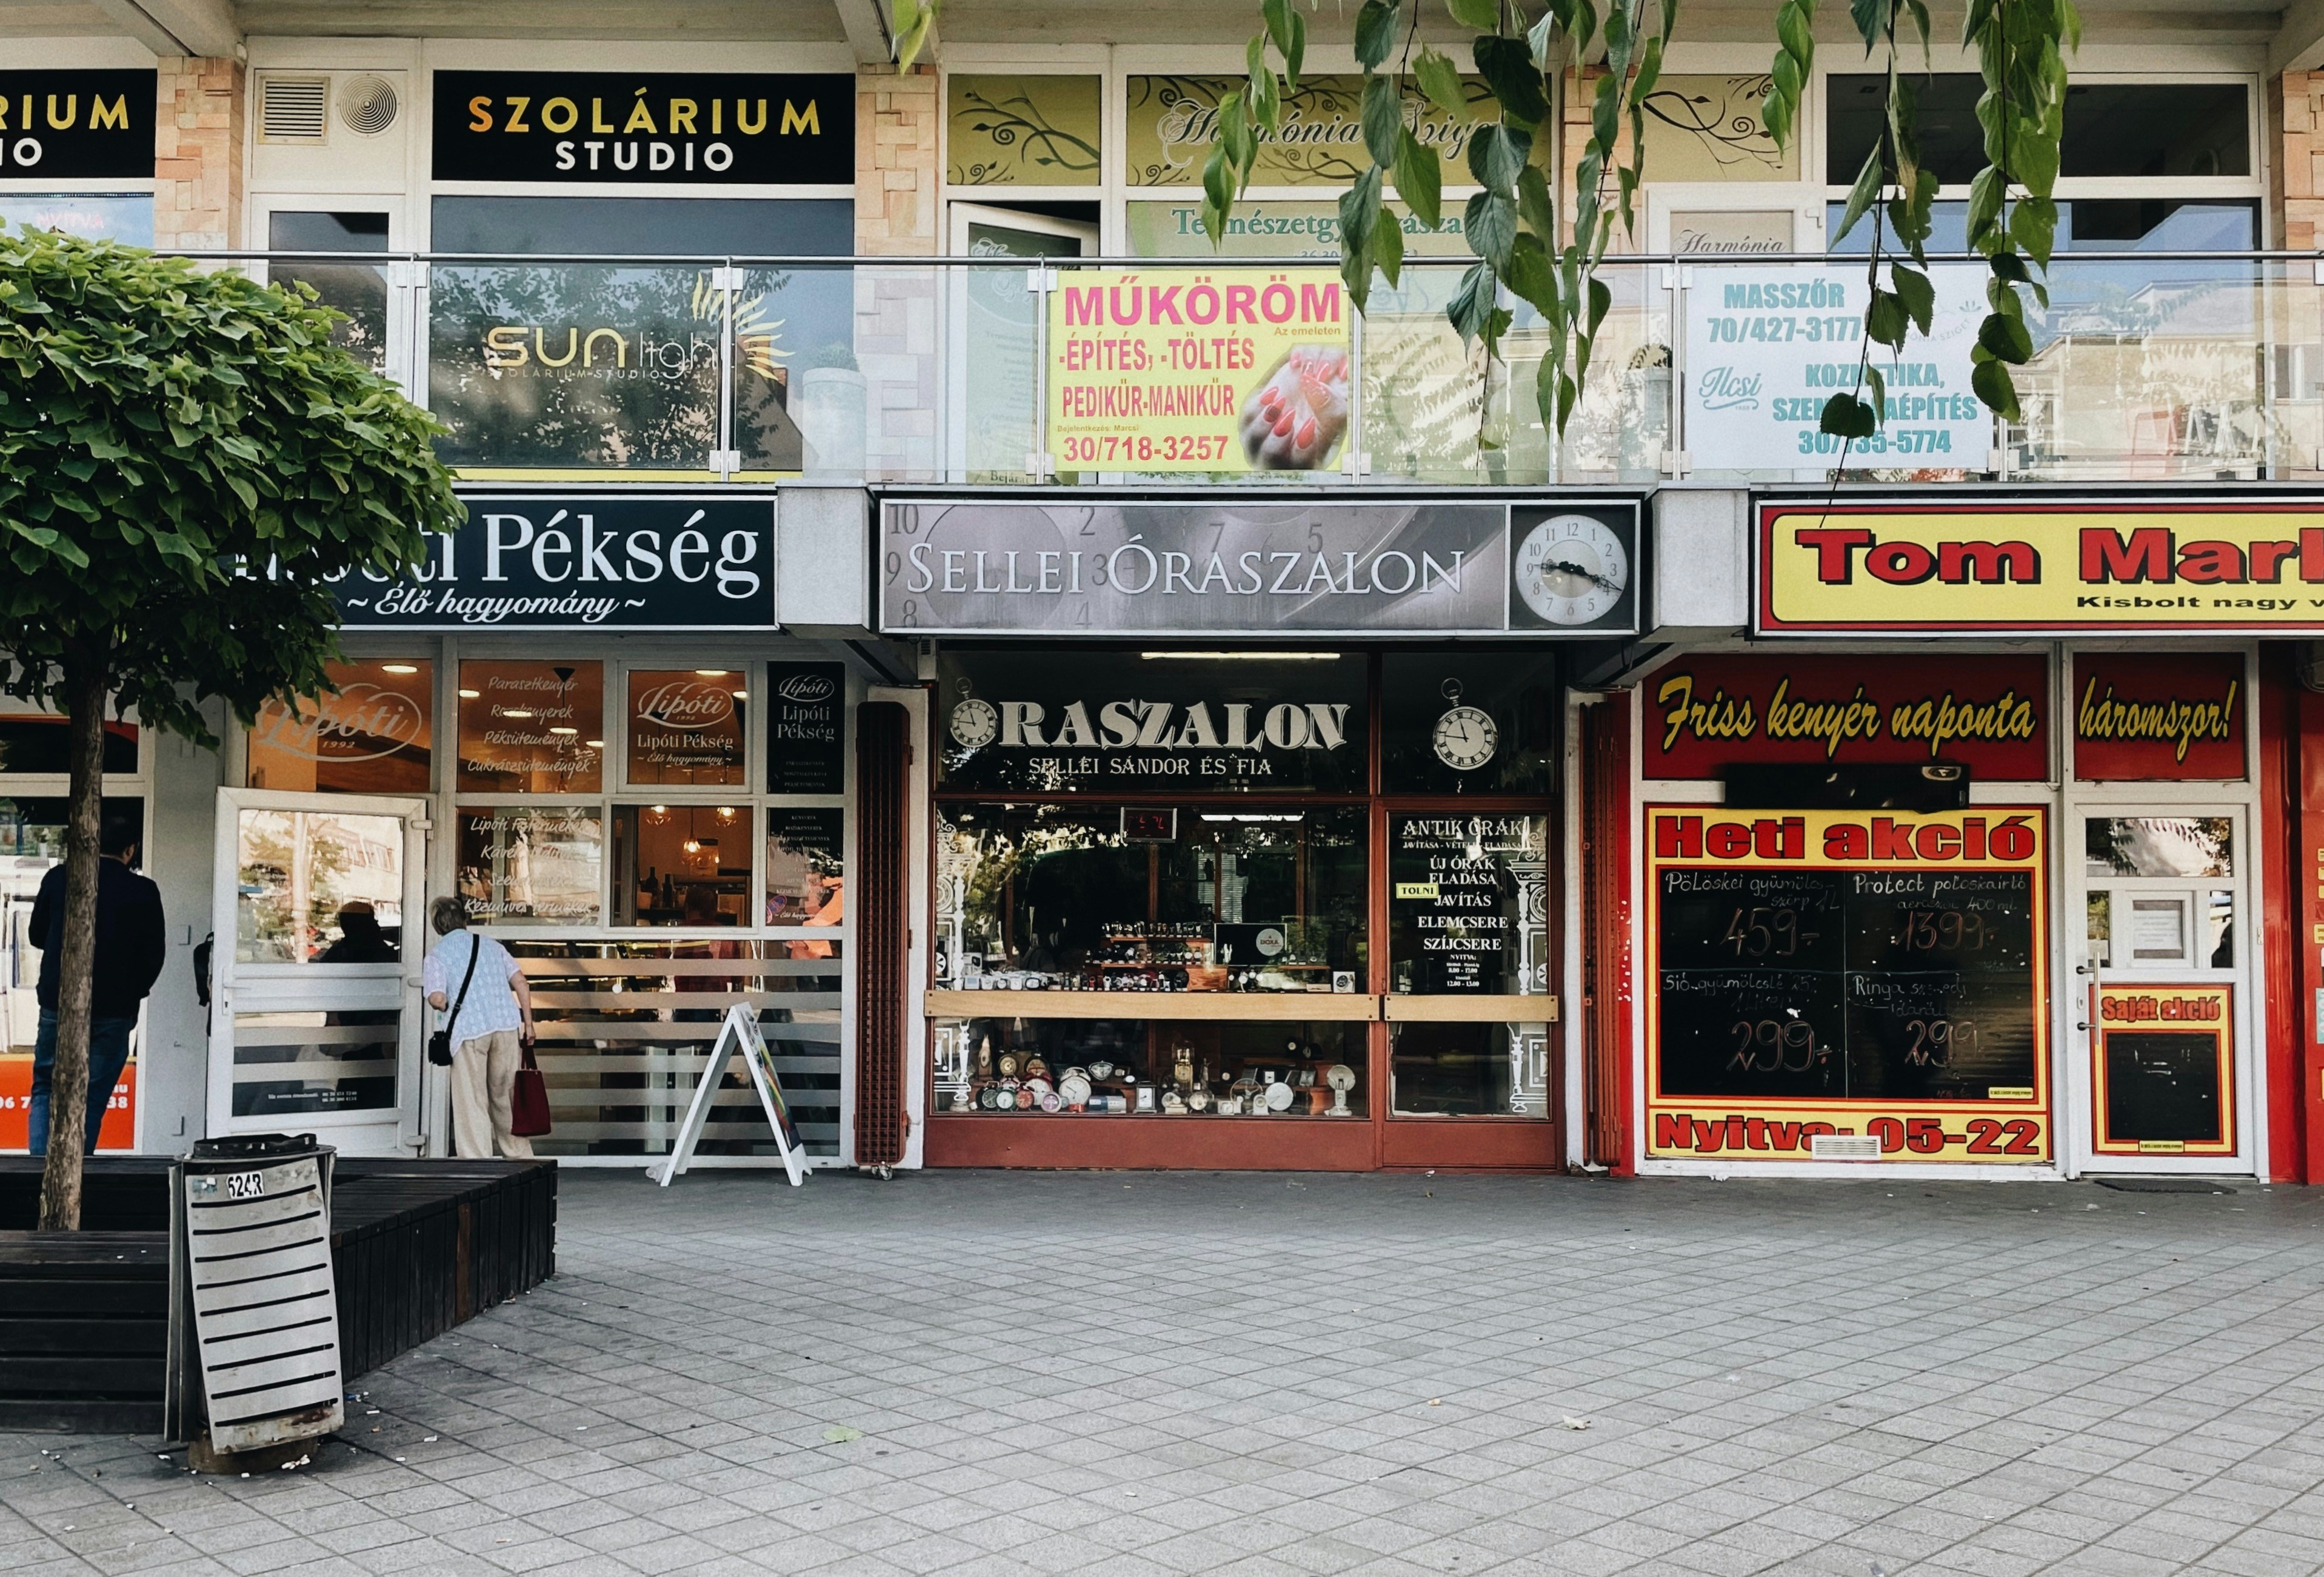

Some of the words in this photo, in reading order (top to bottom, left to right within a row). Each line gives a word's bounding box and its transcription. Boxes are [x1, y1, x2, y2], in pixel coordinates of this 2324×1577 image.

[469, 87, 821, 135] SZOLÁRIUM
[555, 141, 734, 172] STUDIO
[1671, 230, 1787, 254] Harmónia
[1064, 275, 1341, 326] MŰKÖRÖM
[1724, 278, 1845, 308] MASSZŐR
[1274, 327, 1289, 336] Az
[1292, 327, 1341, 336] emeleten
[1707, 316, 1862, 343] 70/427-3177
[1059, 331, 1154, 371] -ÉPÍTÉS,
[1161, 330, 1255, 370] -TÖLTÉS
[1698, 366, 1763, 398] Ilcsi
[1063, 378, 1235, 417] PEDIKÜR-MANIKÜR
[1063, 435, 1229, 462] 30/718-3257
[1546, 527, 1556, 541] 11
[1566, 522, 1579, 536] 12
[1591, 527, 1596, 541] 1
[481, 508, 760, 599] Pékség
[1529, 543, 1541, 557] 10
[1605, 543, 1612, 557] 2
[1795, 528, 2042, 585] Tom
[907, 542, 1084, 594] SELLEI
[1107, 533, 1464, 595] ÓRASZALON
[1527, 562, 1534, 577] 9
[1609, 563, 1617, 576] 3
[1533, 582, 1540, 595] 8
[375, 583, 429, 615] Élő
[435, 588, 619, 624] hagyomány
[1546, 598, 1554, 611] 7
[1567, 603, 1575, 616] 6
[1587, 598, 1595, 612] 5
[2077, 596, 2201, 608] Kisbolt
[2213, 598, 2296, 610] nagy
[783, 705, 830, 724] Lipóti
[1658, 675, 1758, 752] Friss
[1766, 678, 1881, 758] kenyér
[1891, 690, 2037, 758] naponta
[2079, 675, 2238, 762] háromszor!
[777, 723, 835, 742] Pékség
[998, 698, 1352, 753] RASZALON
[638, 733, 680, 750] Lipóti
[683, 733, 733, 751] Pékség
[1110, 755, 1190, 775] SÁNDOR
[1200, 755, 1226, 775] ÉS
[1237, 758, 1273, 775] FIA
[1402, 820, 1463, 836] ANTIK
[1655, 815, 1806, 859] Heti
[1822, 815, 2037, 861] akció
[1430, 855, 1446, 870] ÚJ
[1401, 886, 1434, 895] TOLNI
[1853, 873, 1925, 895] Protect
[1434, 891, 1492, 907] JAVÍTÁS
[1417, 916, 1509, 929] ELEMCSERE
[1423, 935, 1502, 950] SZÍJCSERE
[2101, 996, 2159, 1023] Saját
[2160, 995, 2222, 1022] akció
[1867, 1117, 2040, 1155] 05-22
